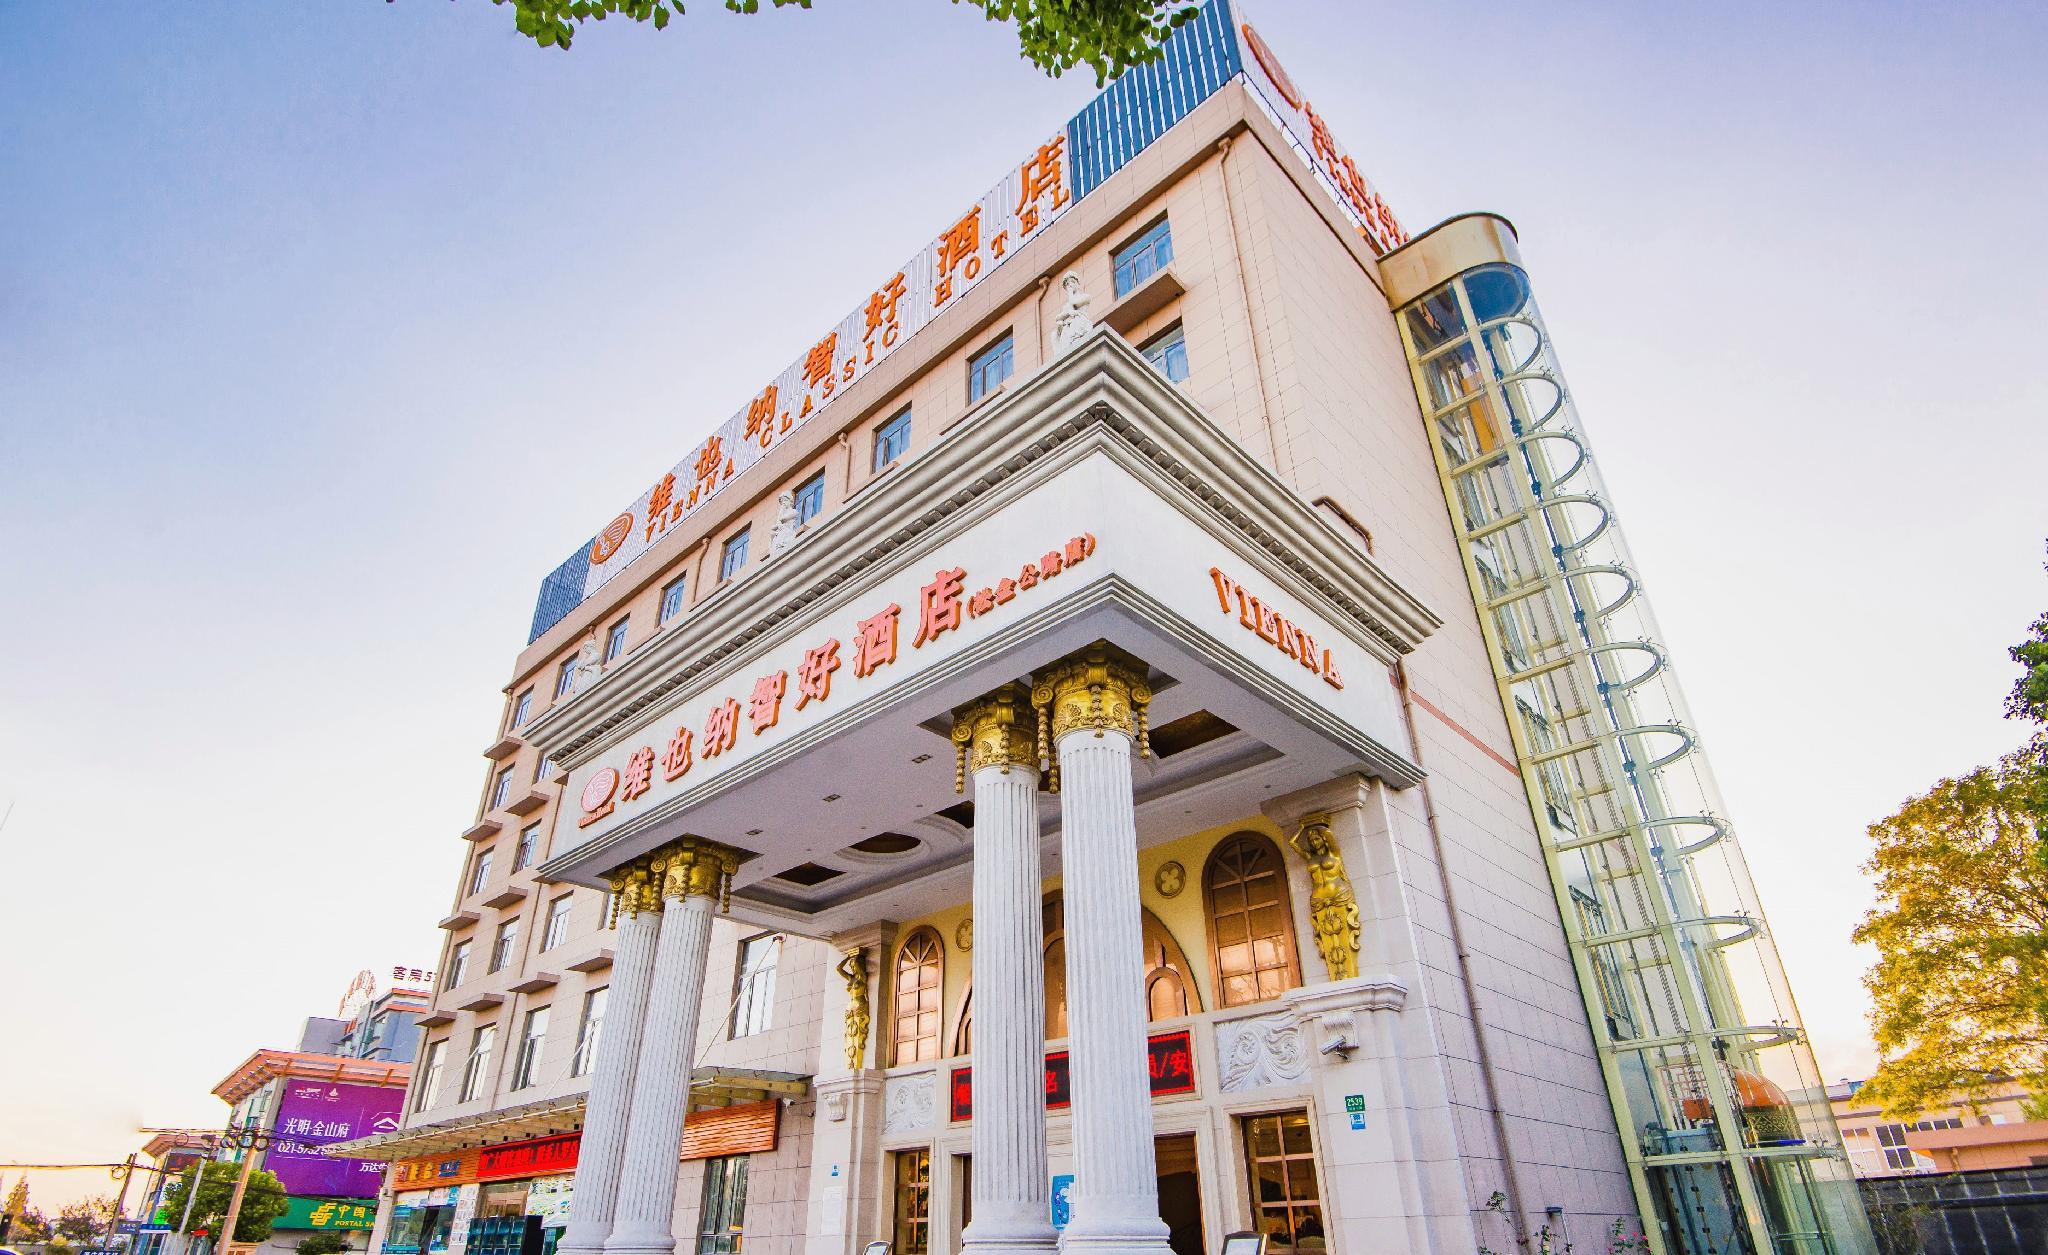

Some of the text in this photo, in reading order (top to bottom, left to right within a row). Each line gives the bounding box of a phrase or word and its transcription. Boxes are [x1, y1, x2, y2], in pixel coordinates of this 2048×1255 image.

[646, 184, 1070, 543] VIENNA CLASSIC HOTEL
[647, 135, 1066, 522] 维也纳智好酒店
[620, 567, 967, 801] 维也纳智好酒店
[1209, 566, 1345, 690] VIENNA
[1346, 1097, 1363, 1107] 2539
